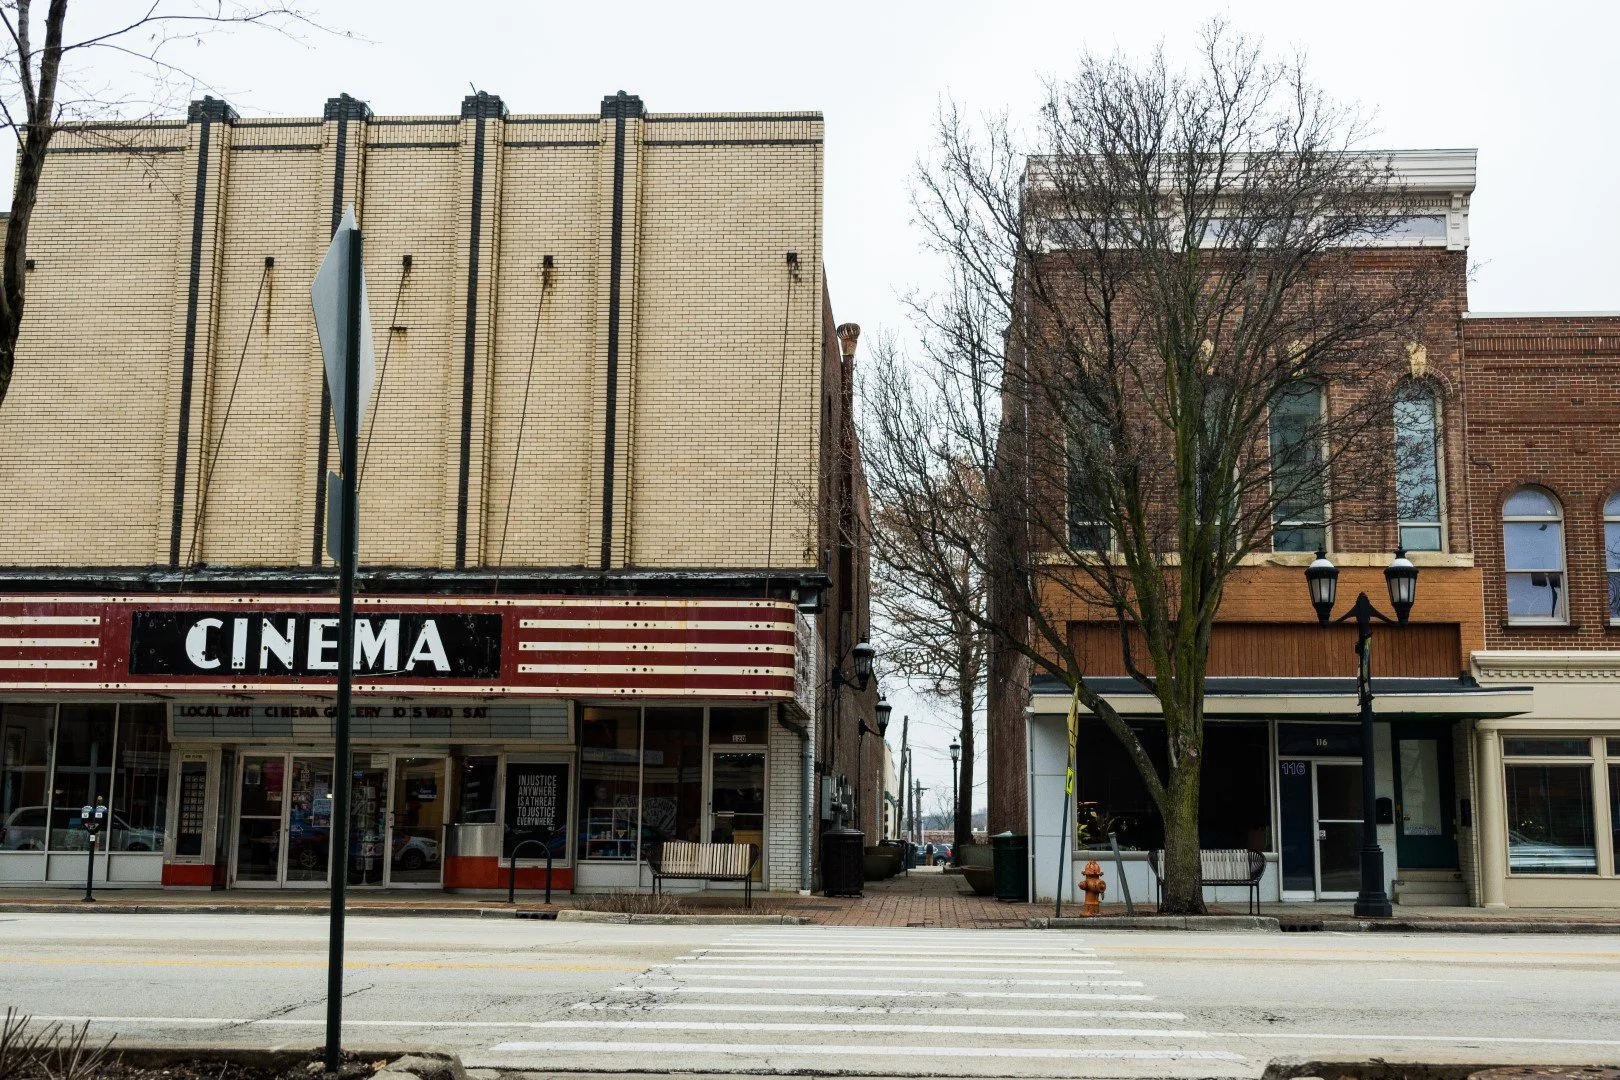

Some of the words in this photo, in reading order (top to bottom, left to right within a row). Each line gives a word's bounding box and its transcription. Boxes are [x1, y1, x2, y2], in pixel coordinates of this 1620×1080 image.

[185, 618, 452, 672] CINEMA
[181, 706, 222, 717] LOCAL
[227, 706, 252, 717] ART
[265, 706, 319, 718] CINEMA
[324, 707, 382, 718] GAERY
[393, 707, 406, 718] 10
[412, 707, 422, 718] 5
[426, 707, 453, 718] WED
[463, 707, 488, 718] SAT
[1316, 738, 1328, 746] 116
[1281, 762, 1306, 775] 116
[518, 775, 557, 786] INJUSTICE
[518, 786, 557, 796] ANYWHERE
[517, 796, 524, 807] IS
[525, 796, 530, 807] A
[530, 796, 557, 807] THREAT
[517, 806, 526, 817] TO
[527, 806, 556, 817] JUSTICE
